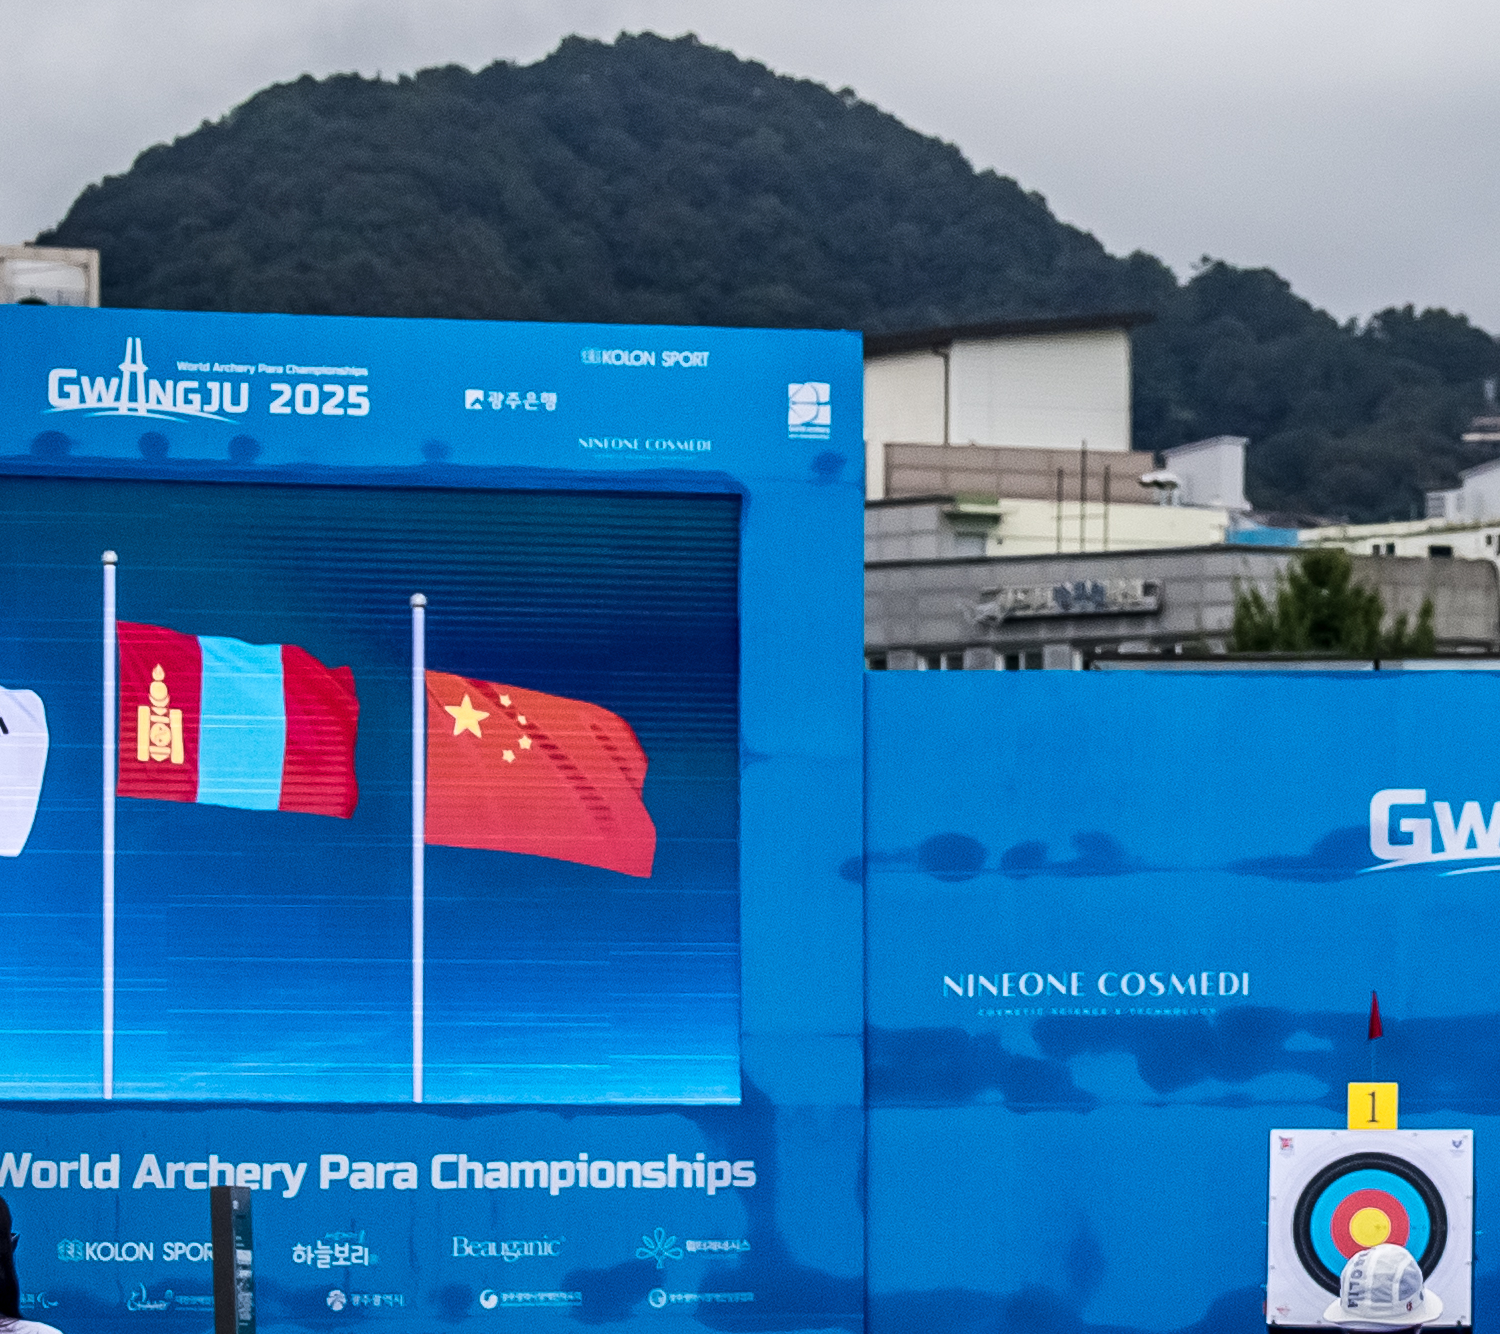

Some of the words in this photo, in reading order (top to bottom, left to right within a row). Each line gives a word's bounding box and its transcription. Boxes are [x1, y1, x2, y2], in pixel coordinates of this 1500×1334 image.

[602, 349, 655, 366] KOLON
[662, 350, 710, 368] SPORT
[48, 337, 250, 415] GWANGJU
[269, 382, 371, 417] 2025
[942, 971, 1085, 998] NINEONE
[1098, 971, 1249, 997] COSMEDI
[1367, 1091, 1379, 1123] 1
[132, 1154, 308, 1199] Archery
[319, 1153, 419, 1191] Para
[431, 1153, 757, 1197] Championships
[85, 1240, 154, 1262] KOLON
[162, 1240, 214, 1262] SPOR
[290, 1239, 369, 1269] 하늘보리
[452, 1233, 561, 1263] Beauganic
